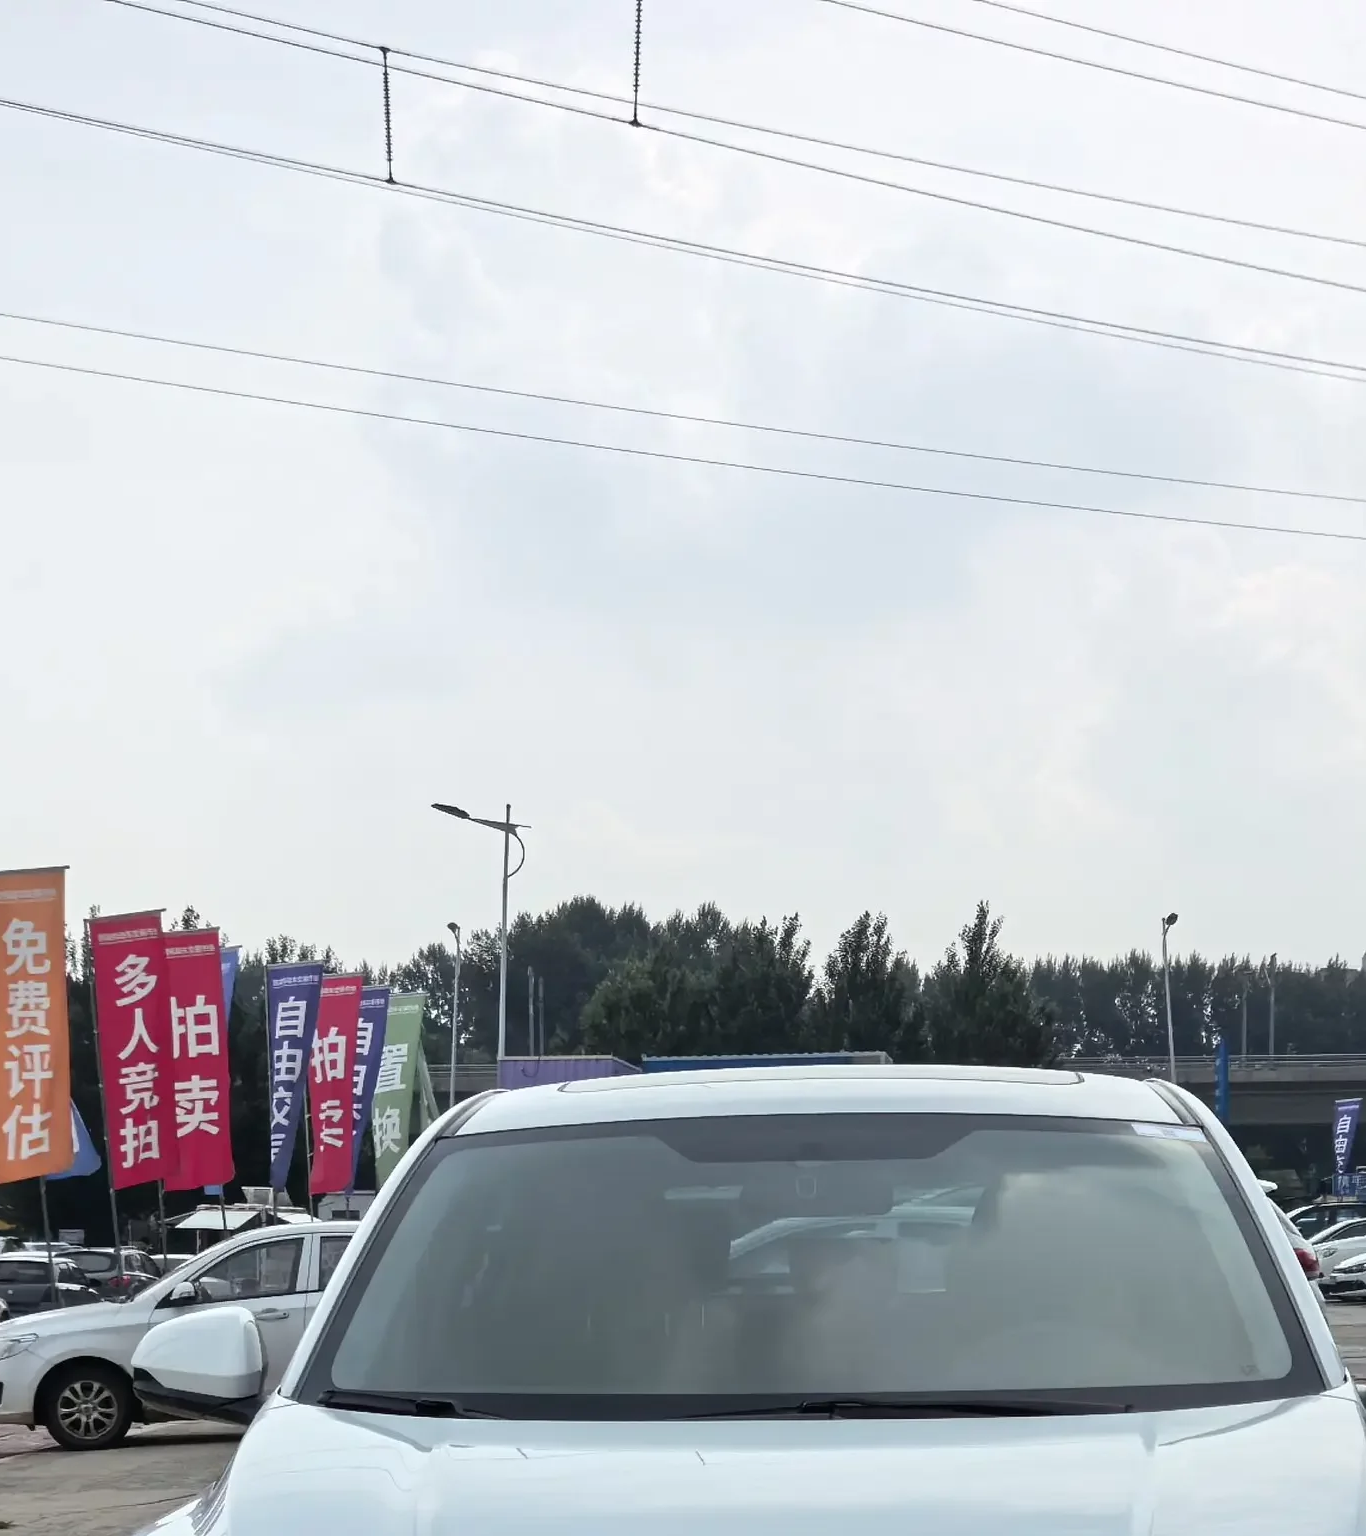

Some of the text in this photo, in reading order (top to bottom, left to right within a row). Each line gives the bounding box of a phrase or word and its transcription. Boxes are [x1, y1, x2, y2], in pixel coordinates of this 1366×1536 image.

[1, 917, 54, 1161] 免费评估
[114, 953, 161, 1169] 多人竞拍
[169, 994, 221, 1138] 拍卖
[372, 1043, 409, 1159] 置换
